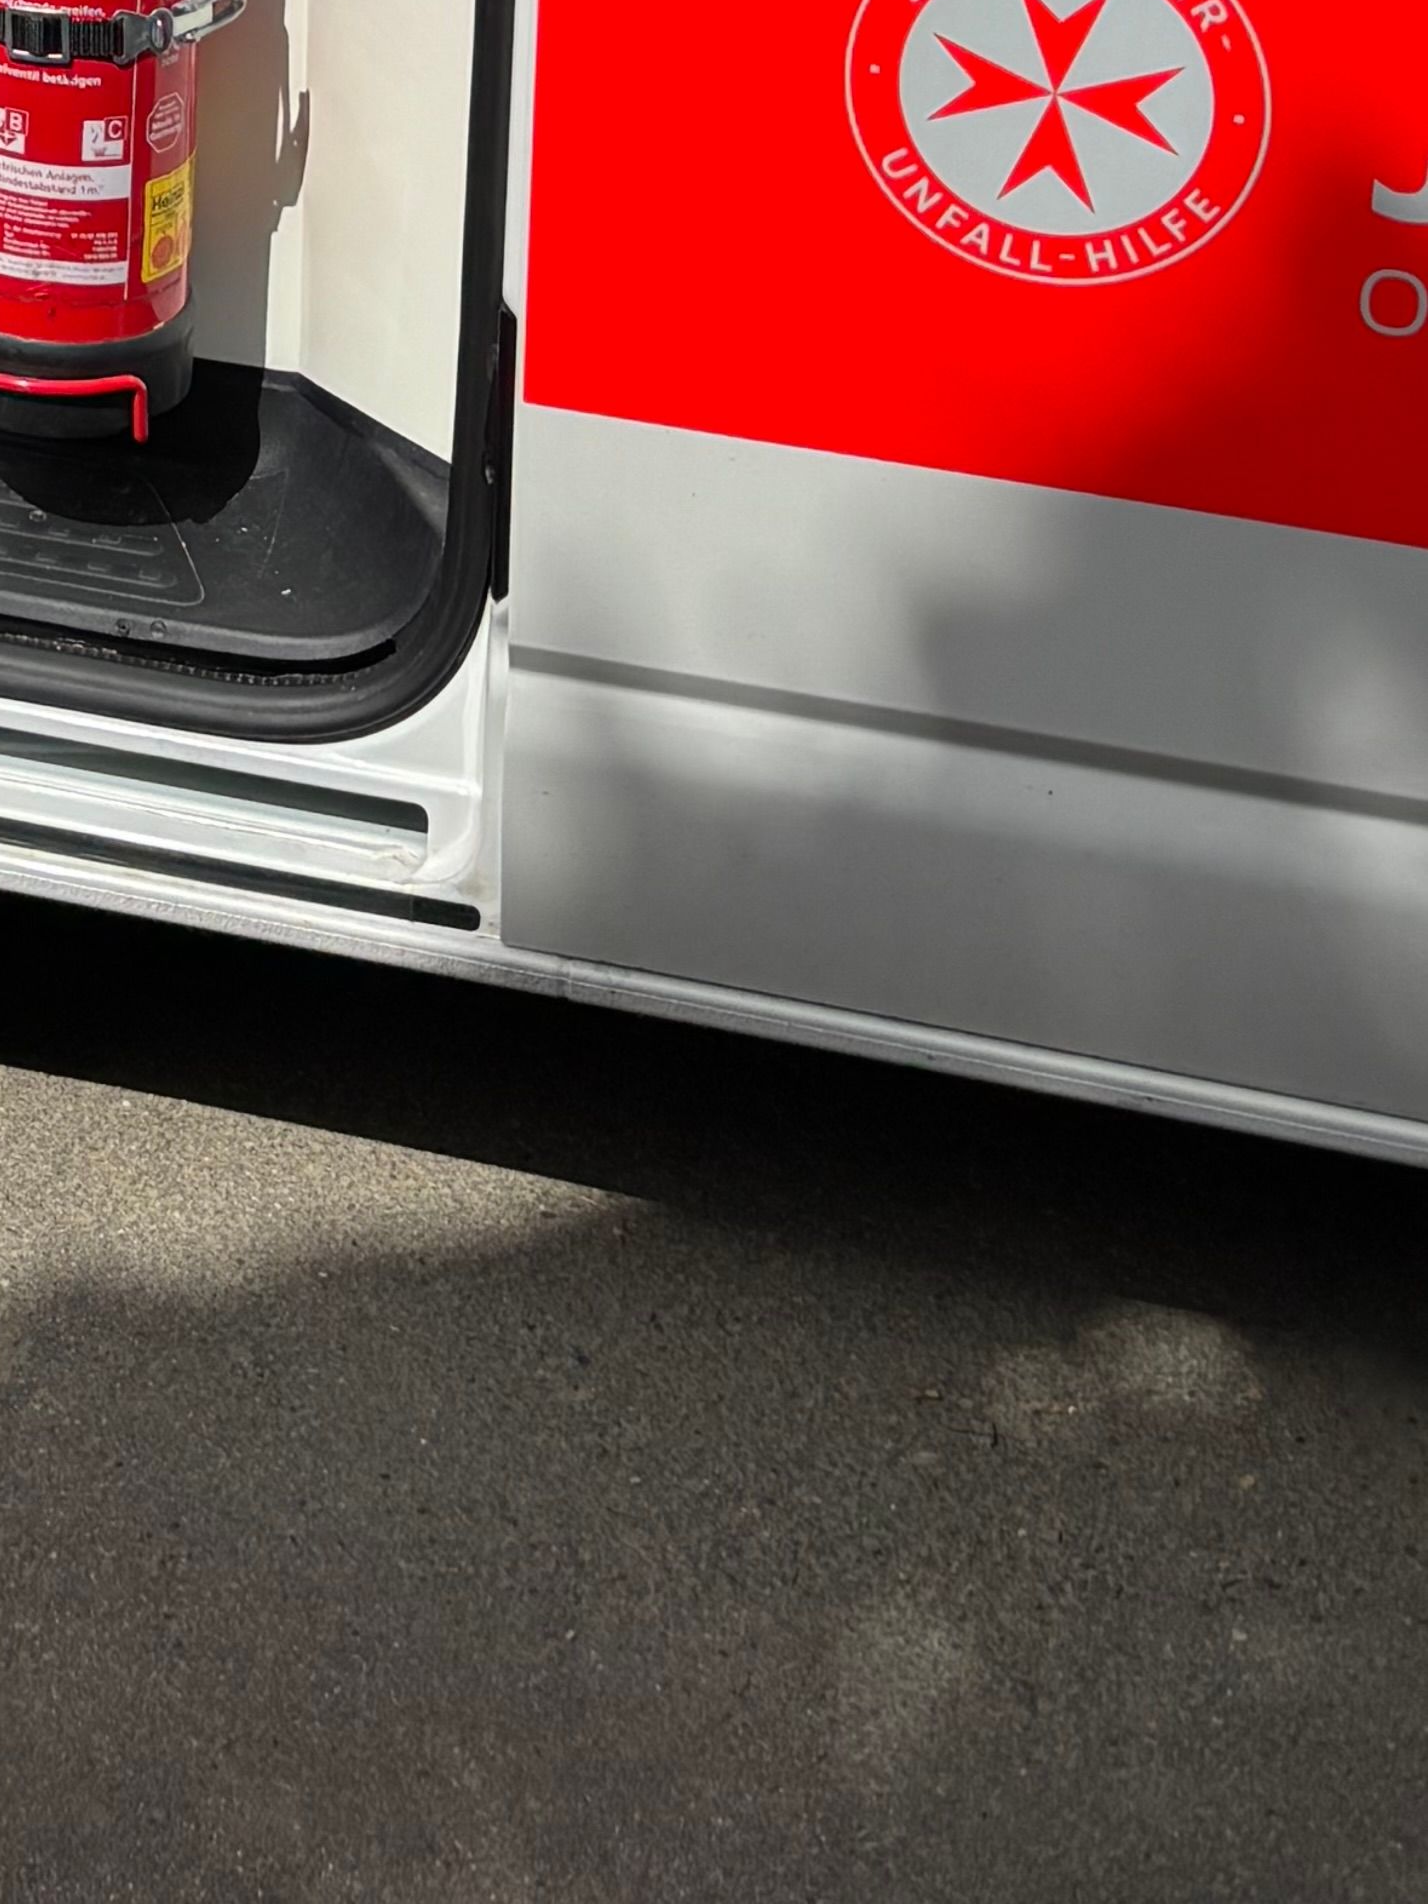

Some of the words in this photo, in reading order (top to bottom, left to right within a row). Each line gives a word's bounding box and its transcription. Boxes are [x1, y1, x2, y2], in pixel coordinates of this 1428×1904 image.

[9, 112, 24, 132] B
[107, 119, 123, 140] C
[880, 146, 1221, 273] UNFALL-HILFE
